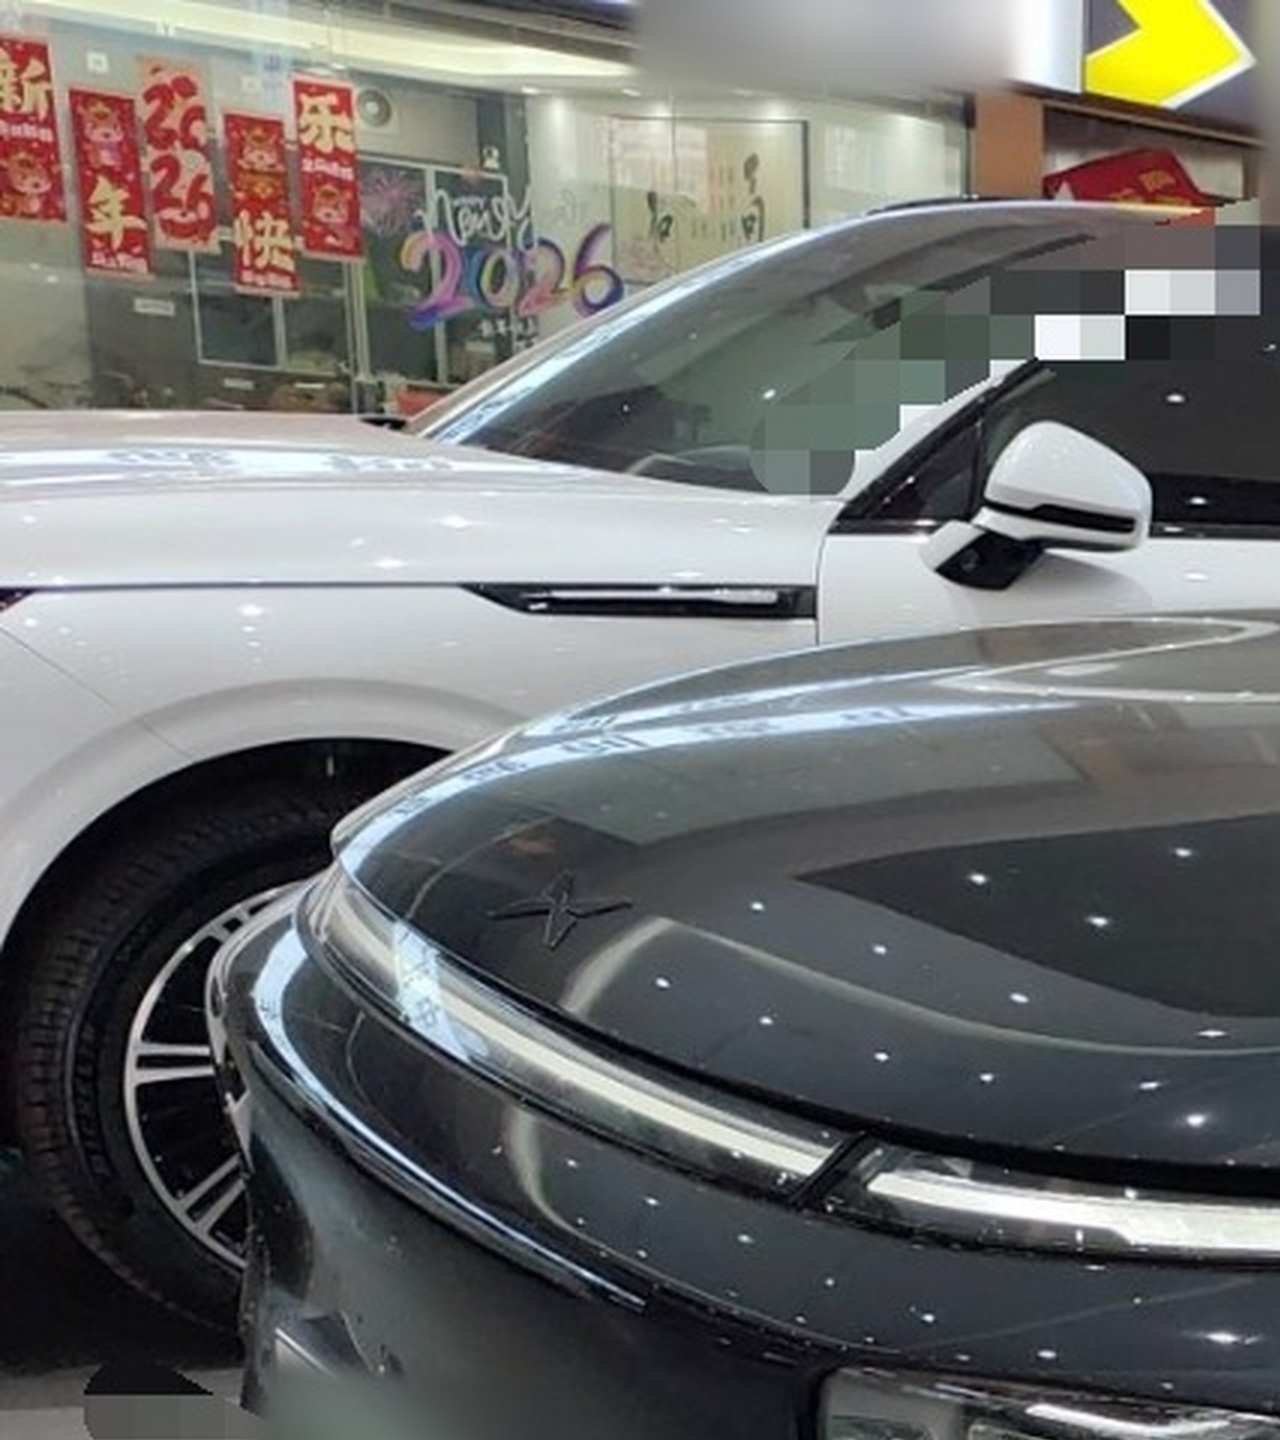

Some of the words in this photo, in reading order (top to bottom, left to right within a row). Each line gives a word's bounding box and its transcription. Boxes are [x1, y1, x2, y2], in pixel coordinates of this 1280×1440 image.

[299, 93, 355, 153] 乐
[84, 174, 147, 250] 年
[234, 209, 295, 270] 快
[400, 222, 625, 330] 2026
